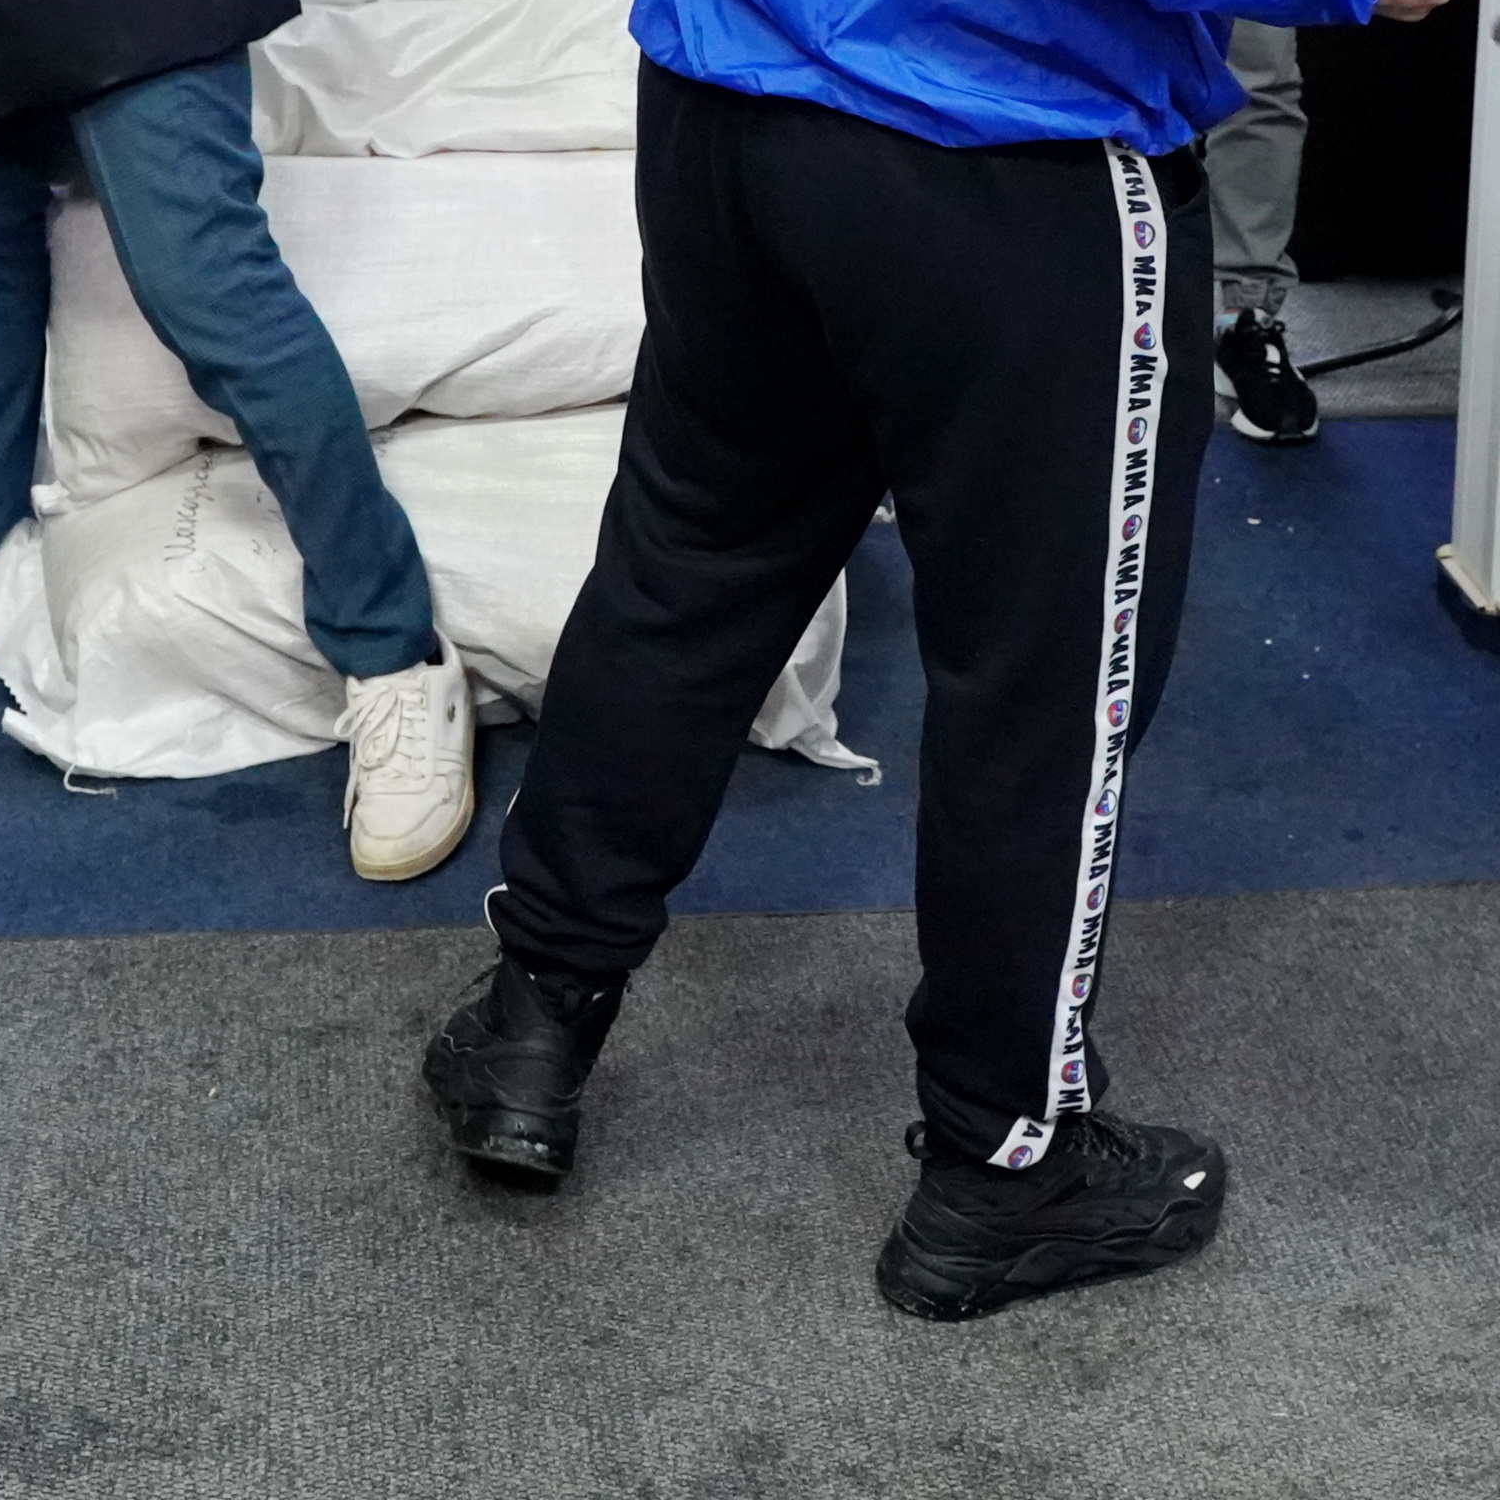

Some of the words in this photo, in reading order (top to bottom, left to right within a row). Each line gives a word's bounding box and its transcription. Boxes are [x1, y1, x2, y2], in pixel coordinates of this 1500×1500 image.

[1117, 155, 1152, 214] MMA
[1134, 255, 1157, 316] MMA
[1128, 354, 1158, 413] MMA
[1123, 448, 1148, 512] MMA
[1114, 542, 1140, 605] MMA
[1106, 633, 1130, 696] MMA
[1088, 821, 1115, 881] MMA
[1073, 911, 1103, 970] MMA
